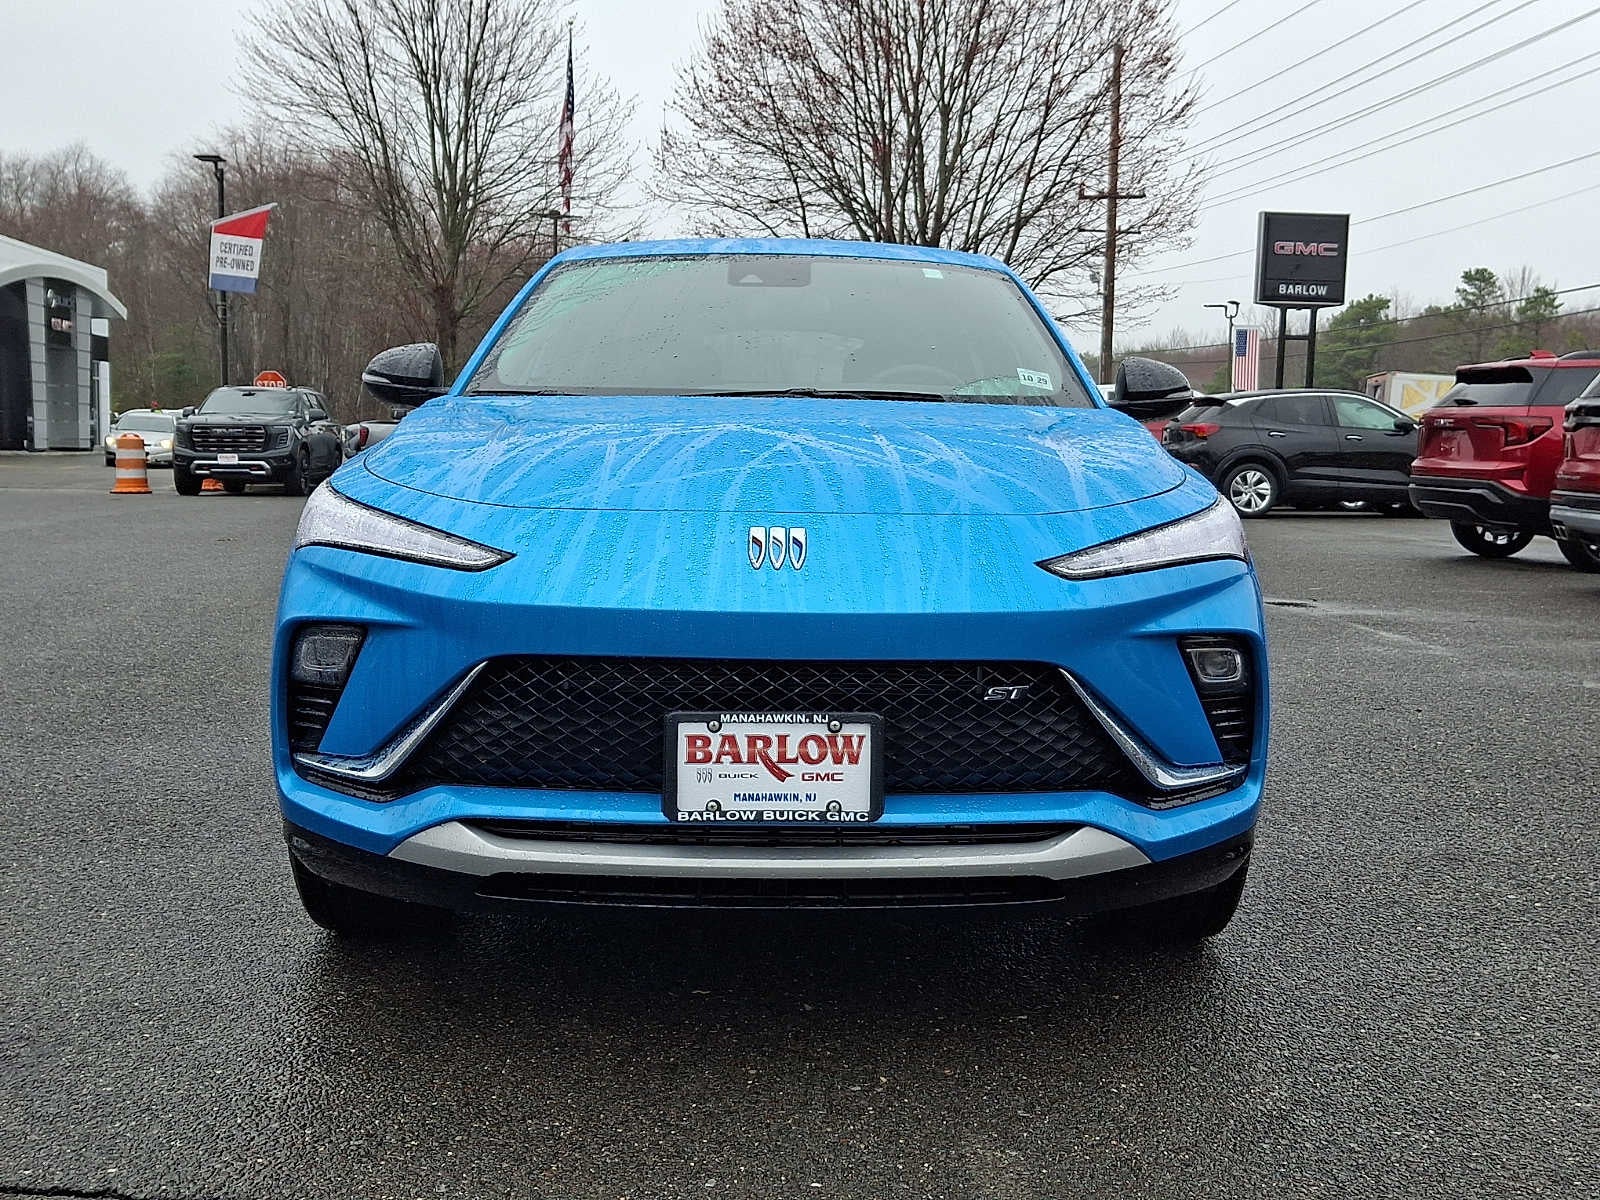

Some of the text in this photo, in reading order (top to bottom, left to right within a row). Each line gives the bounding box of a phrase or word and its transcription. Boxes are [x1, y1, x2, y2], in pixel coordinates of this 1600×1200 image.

[220, 242, 253, 256] CERTIFIED
[1274, 242, 1338, 255] GMC
[215, 256, 254, 271] PRE-OWNED
[1279, 284, 1328, 295] BARLOW
[1022, 374, 1033, 382] 10
[984, 685, 1029, 700] ST
[813, 714, 829, 723] NJ
[684, 733, 866, 783] BARLOW
[801, 772, 844, 782] GMC
[733, 793, 817, 803] MANAHAWKIN, NJ
[677, 811, 869, 821] BARLOW BUICK GMC
